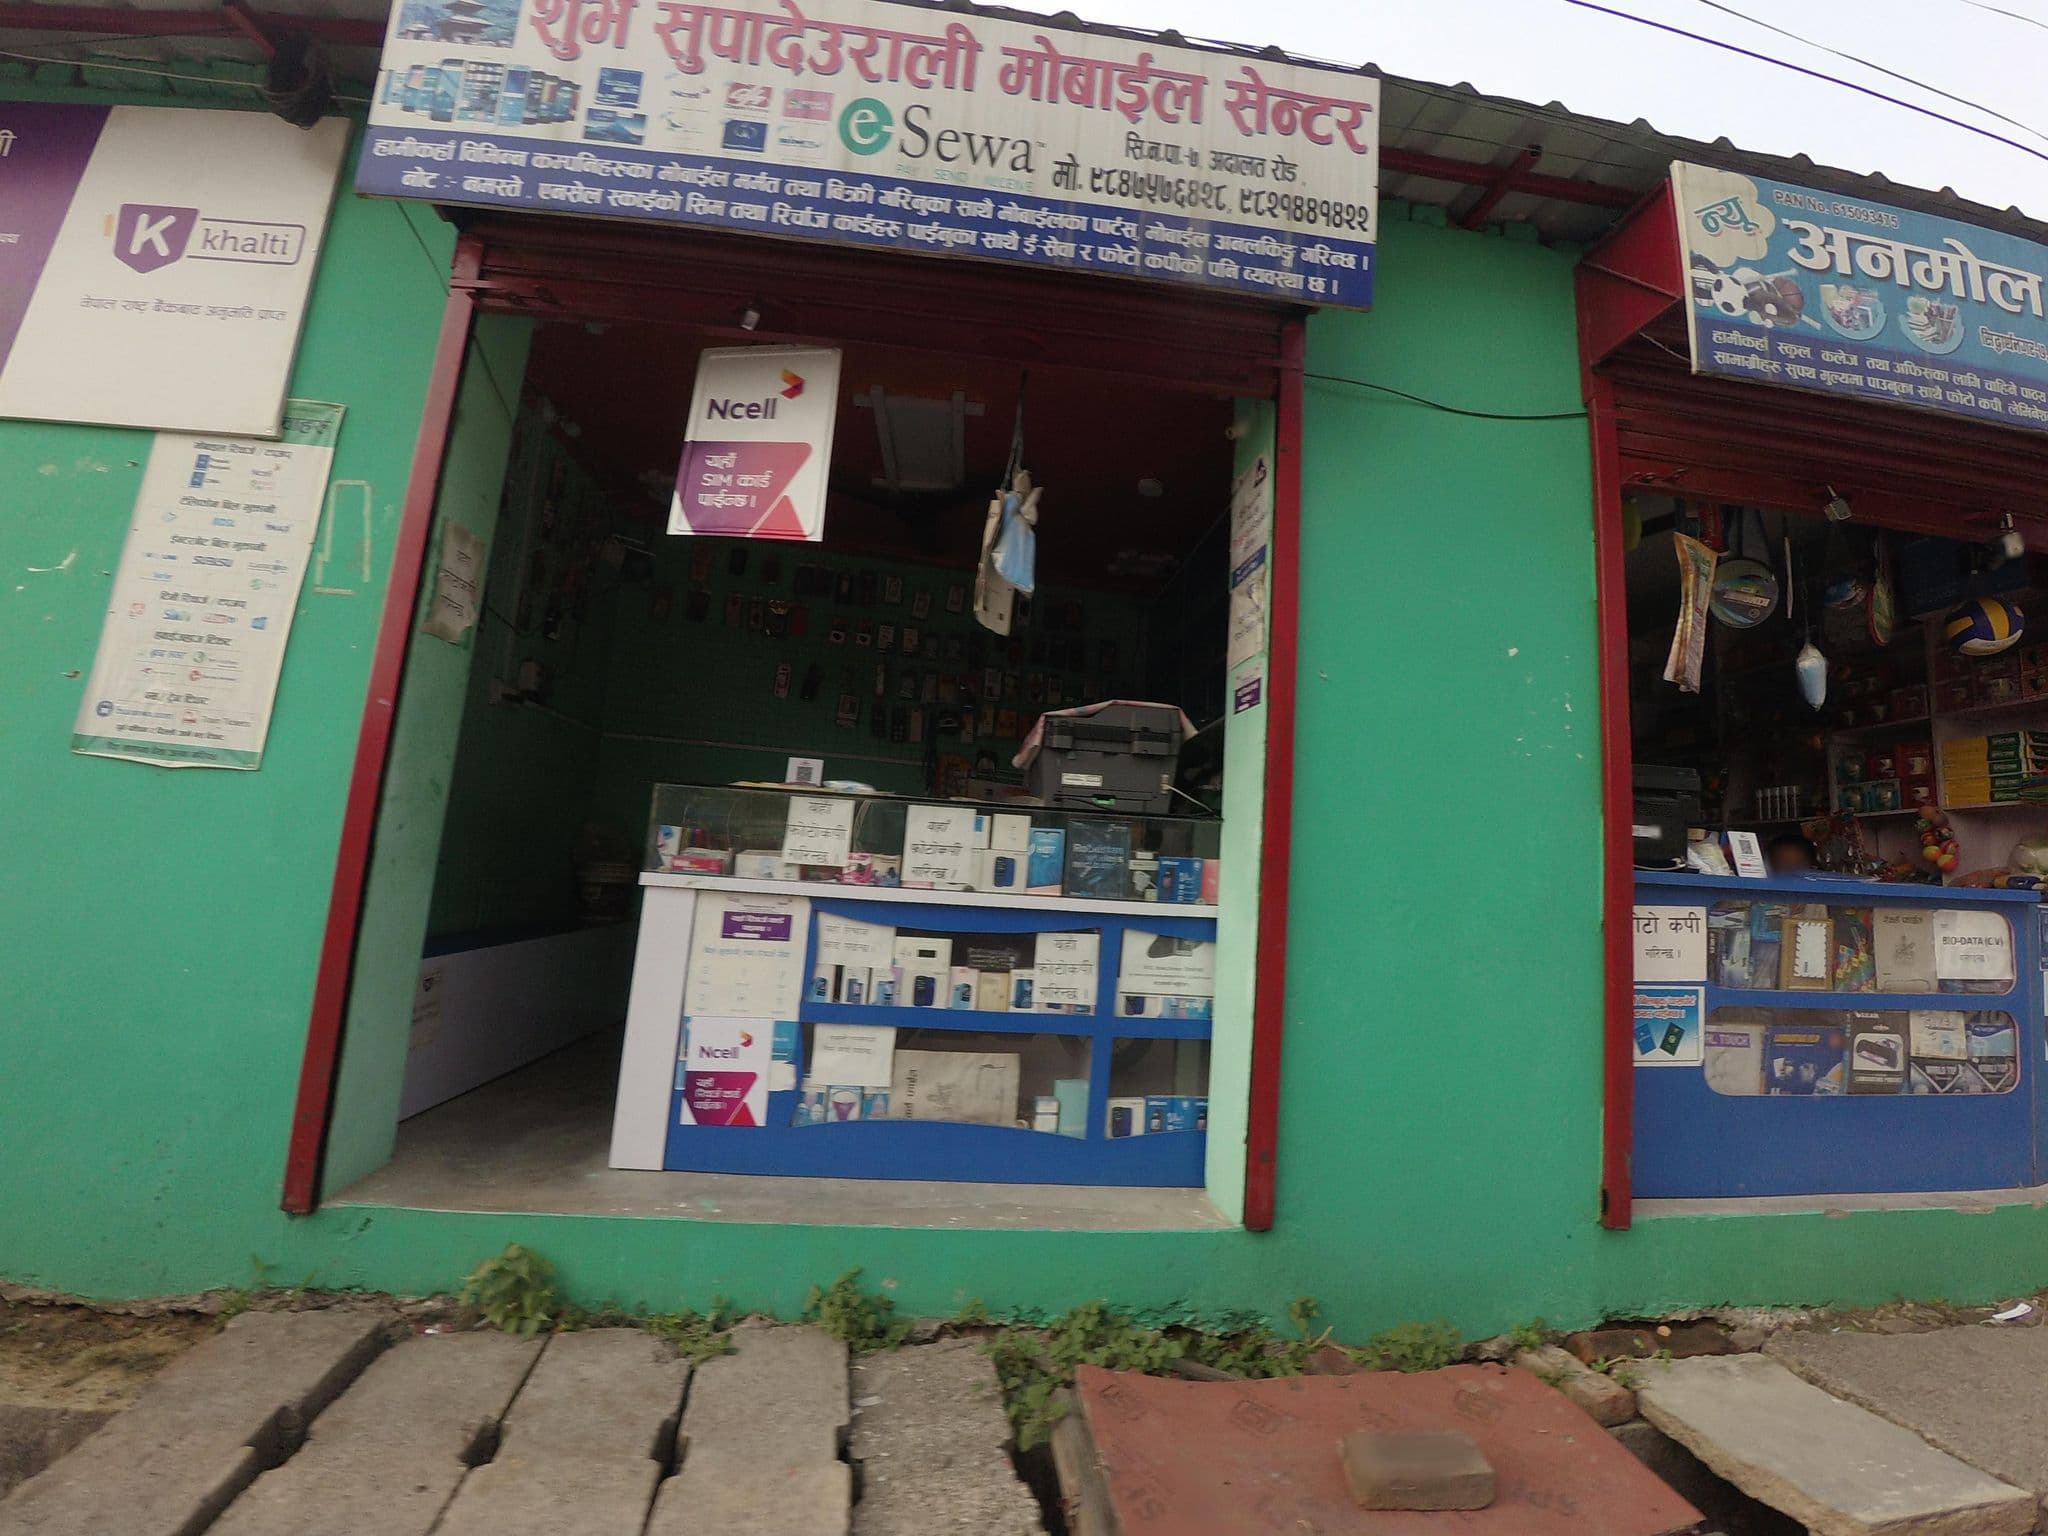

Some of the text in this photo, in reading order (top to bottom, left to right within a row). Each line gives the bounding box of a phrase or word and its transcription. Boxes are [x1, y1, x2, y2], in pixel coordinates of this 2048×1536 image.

[655, 0, 983, 91] सुपादेउराली
[999, 36, 1208, 124] मोबाईल
[1225, 66, 1373, 154] सेन्टर
[1053, 153, 1083, 190] मो.
[1209, 151, 1266, 178] अदालत
[1272, 155, 1298, 182] रोड
[733, 172, 782, 194] मर्मत
[784, 179, 823, 199] तथा
[1774, 189, 1803, 208] PAN
[201, 227, 289, 256] khalti
[686, 192, 728, 217] सिम
[730, 202, 770, 222] तथा
[771, 202, 831, 229] रिचार्ज
[1079, 244, 1096, 261] र
[1098, 243, 1142, 266] फोटो
[1144, 251, 1206, 275] कपीको
[1207, 257, 1241, 280] पनि
[1307, 275, 1328, 294] छ
[1782, 217, 2045, 318] अनमोल
[1865, 356, 1891, 373] तथा
[706, 397, 779, 421] Ncell
[702, 470, 774, 488] SIM कार्ड
[1668, 911, 1701, 935] कपी
[698, 1046, 741, 1060] Ncell
